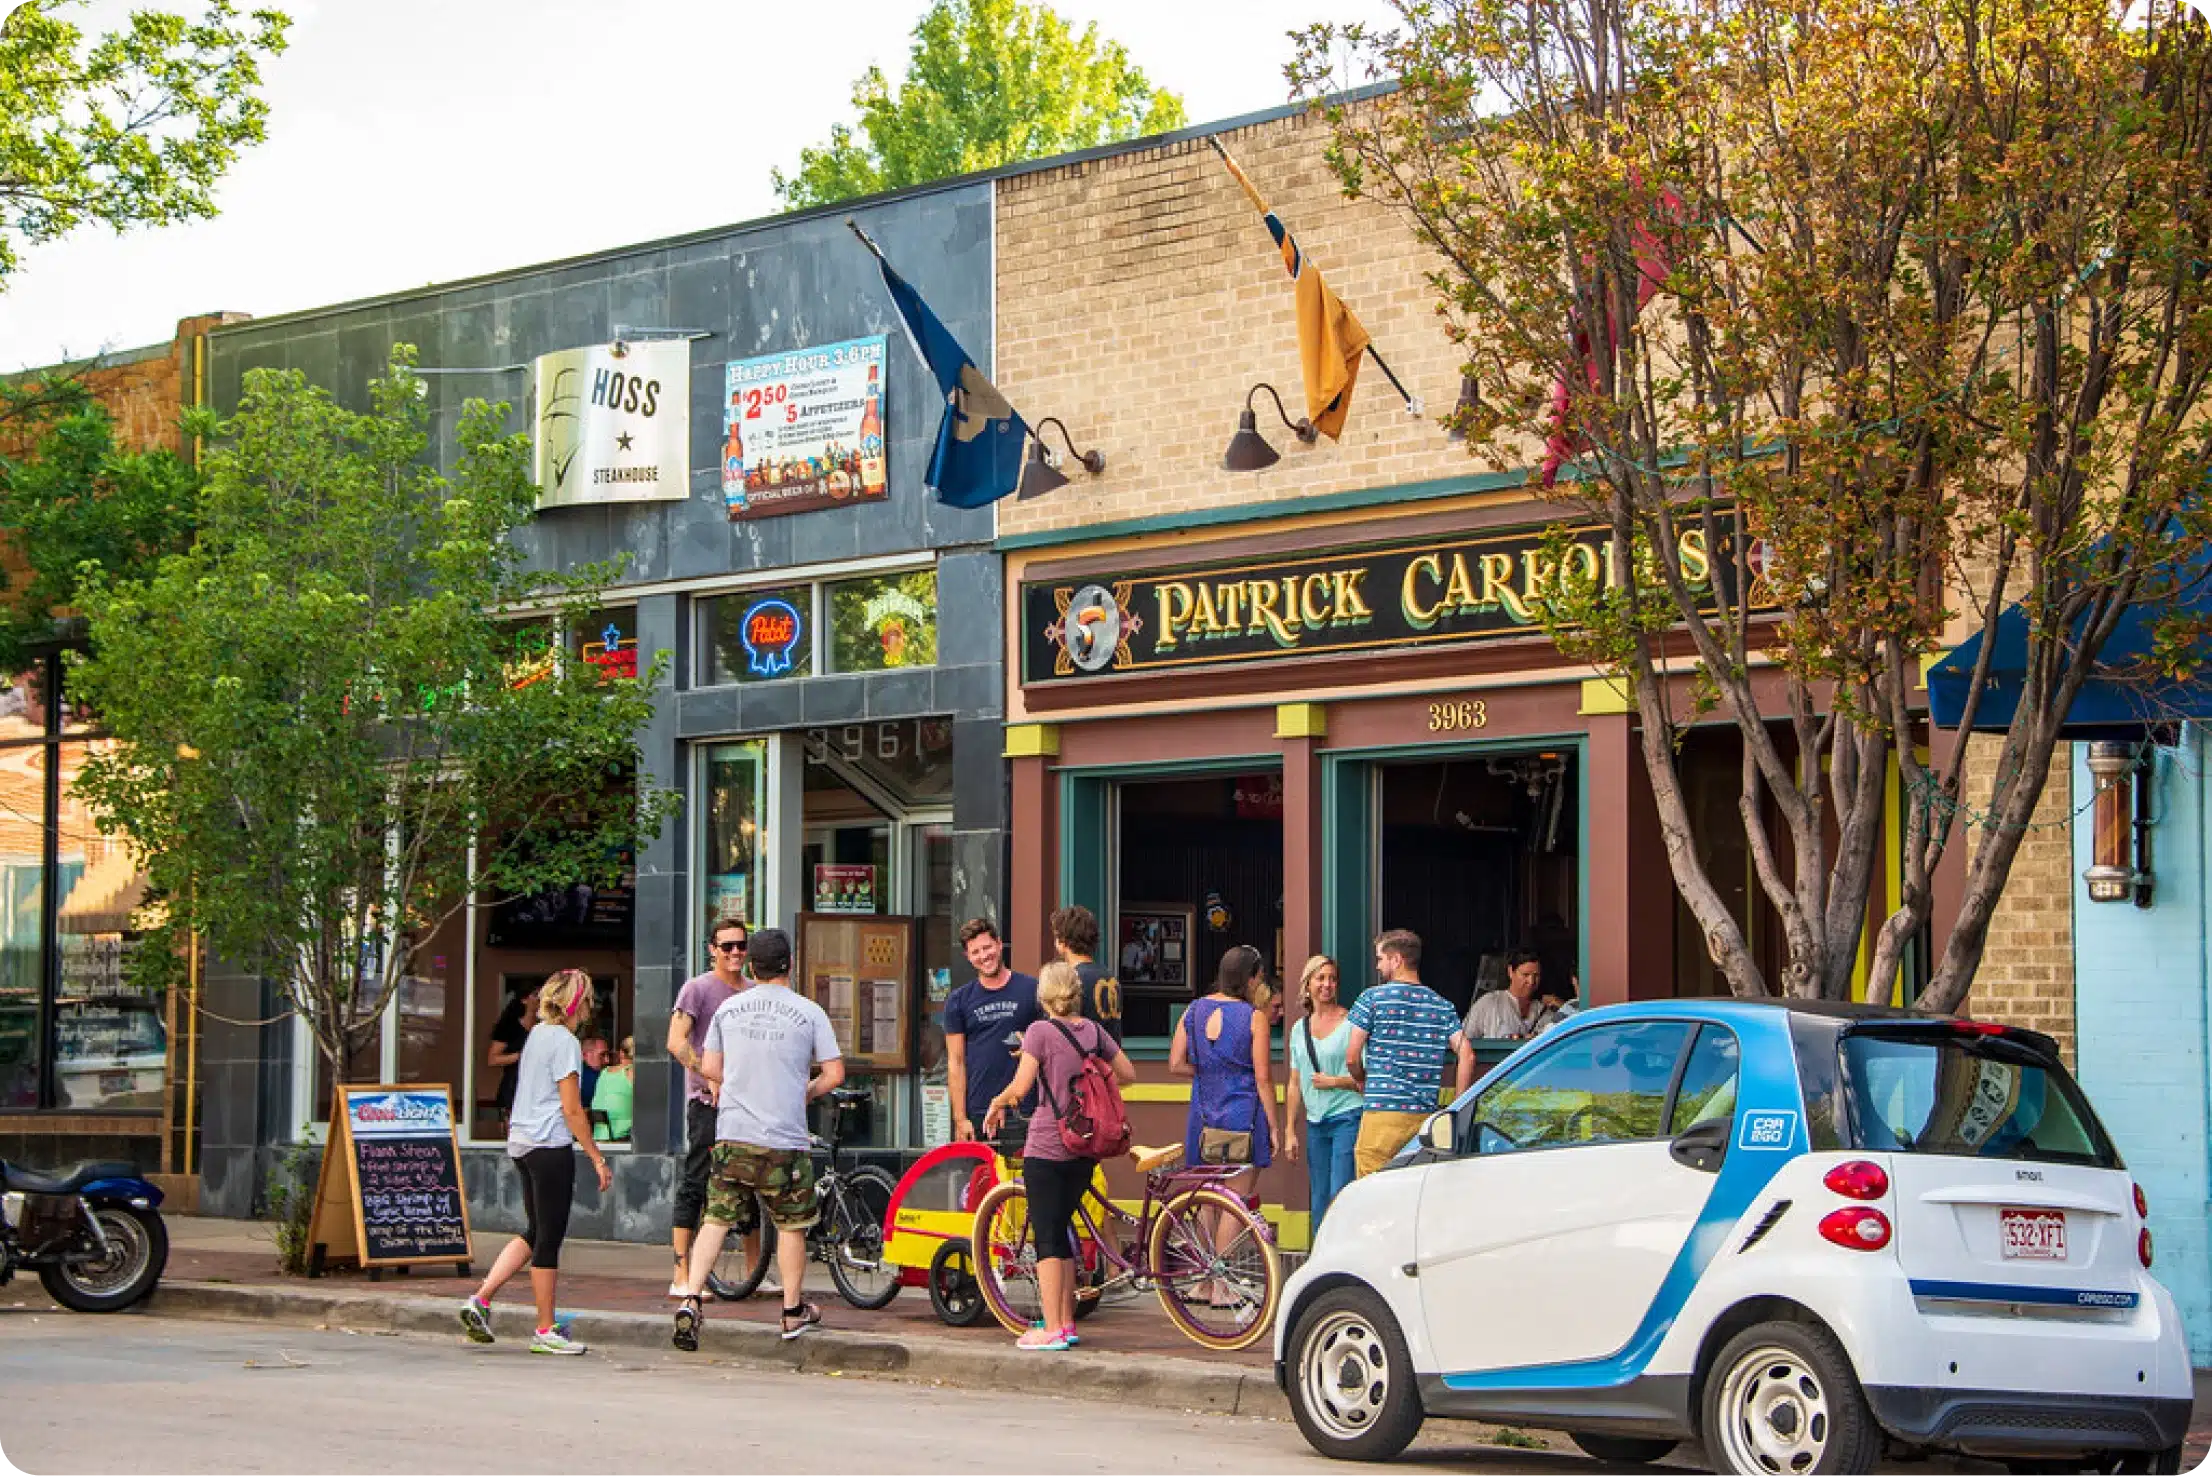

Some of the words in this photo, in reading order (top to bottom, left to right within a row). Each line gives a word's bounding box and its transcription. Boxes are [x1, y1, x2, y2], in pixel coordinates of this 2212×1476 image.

[730, 363, 781, 383] HAPPY
[783, 353, 828, 373] HOUR
[592, 368, 660, 417] HOSS
[594, 466, 659, 485] STEAKHOUSE
[1154, 568, 1372, 653] PATRICK
[1429, 701, 1486, 730] 3963
[808, 720, 921, 765] 3961
[1751, 1130, 1782, 1143] 2GO
[1754, 1117, 1784, 1131] CAR
